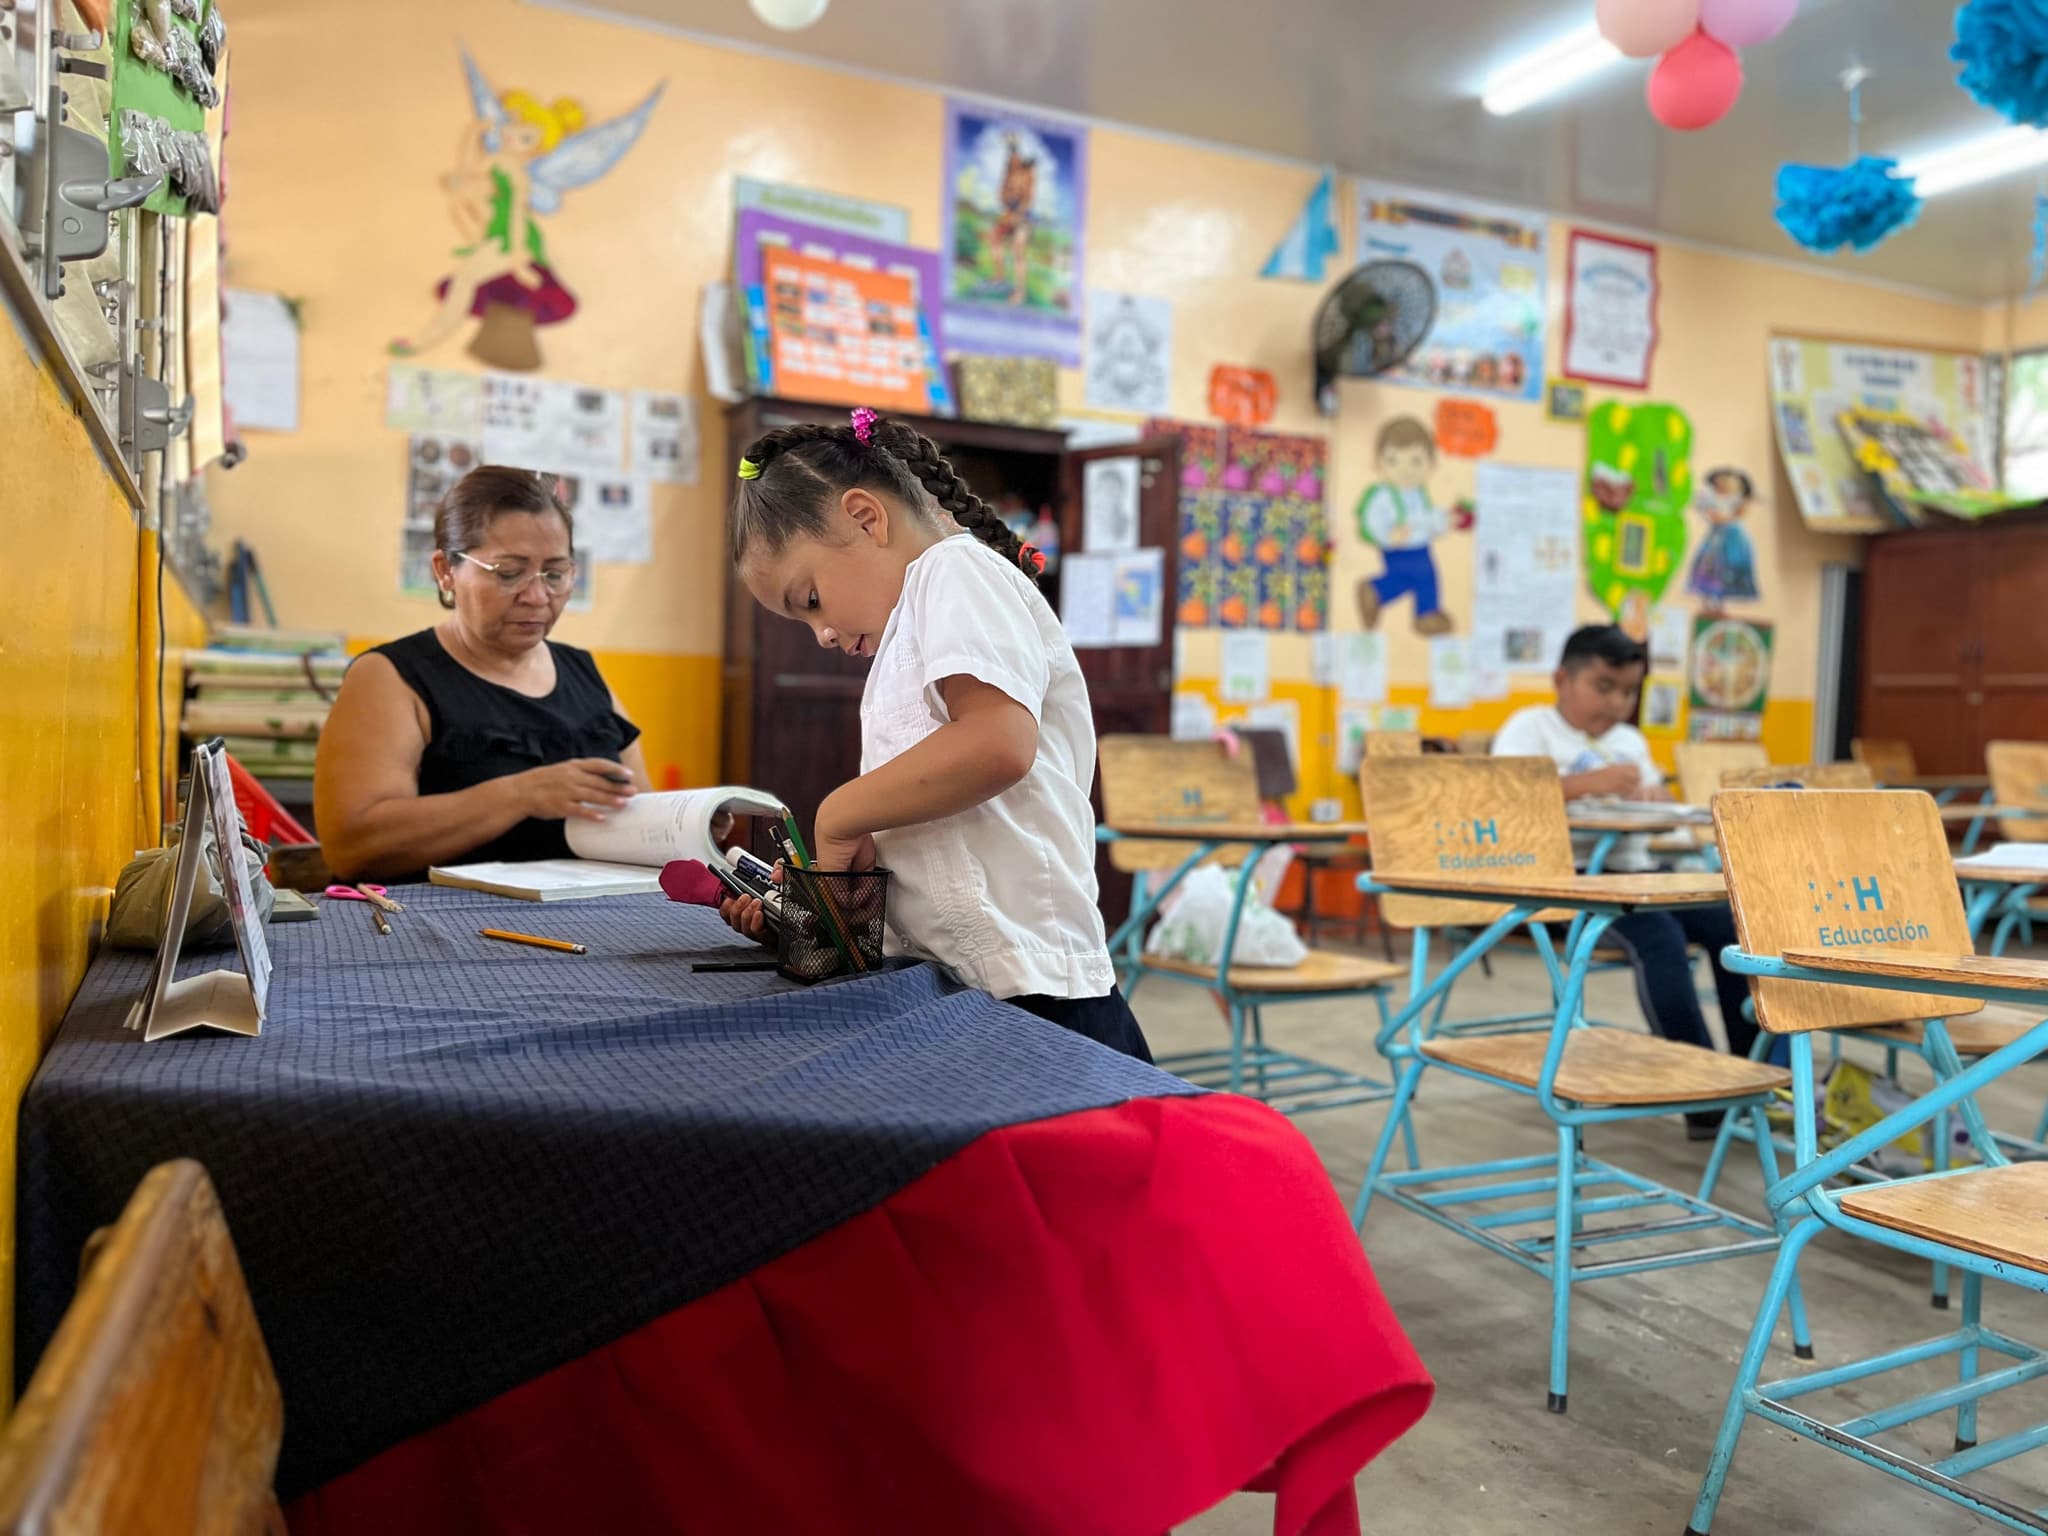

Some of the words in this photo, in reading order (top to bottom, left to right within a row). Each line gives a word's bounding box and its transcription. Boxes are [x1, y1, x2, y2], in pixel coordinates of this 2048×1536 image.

[1473, 817, 1499, 845] H
[1438, 850, 1537, 870] Educación
[1851, 876, 1885, 911] H
[1818, 919, 1929, 947] Educación
